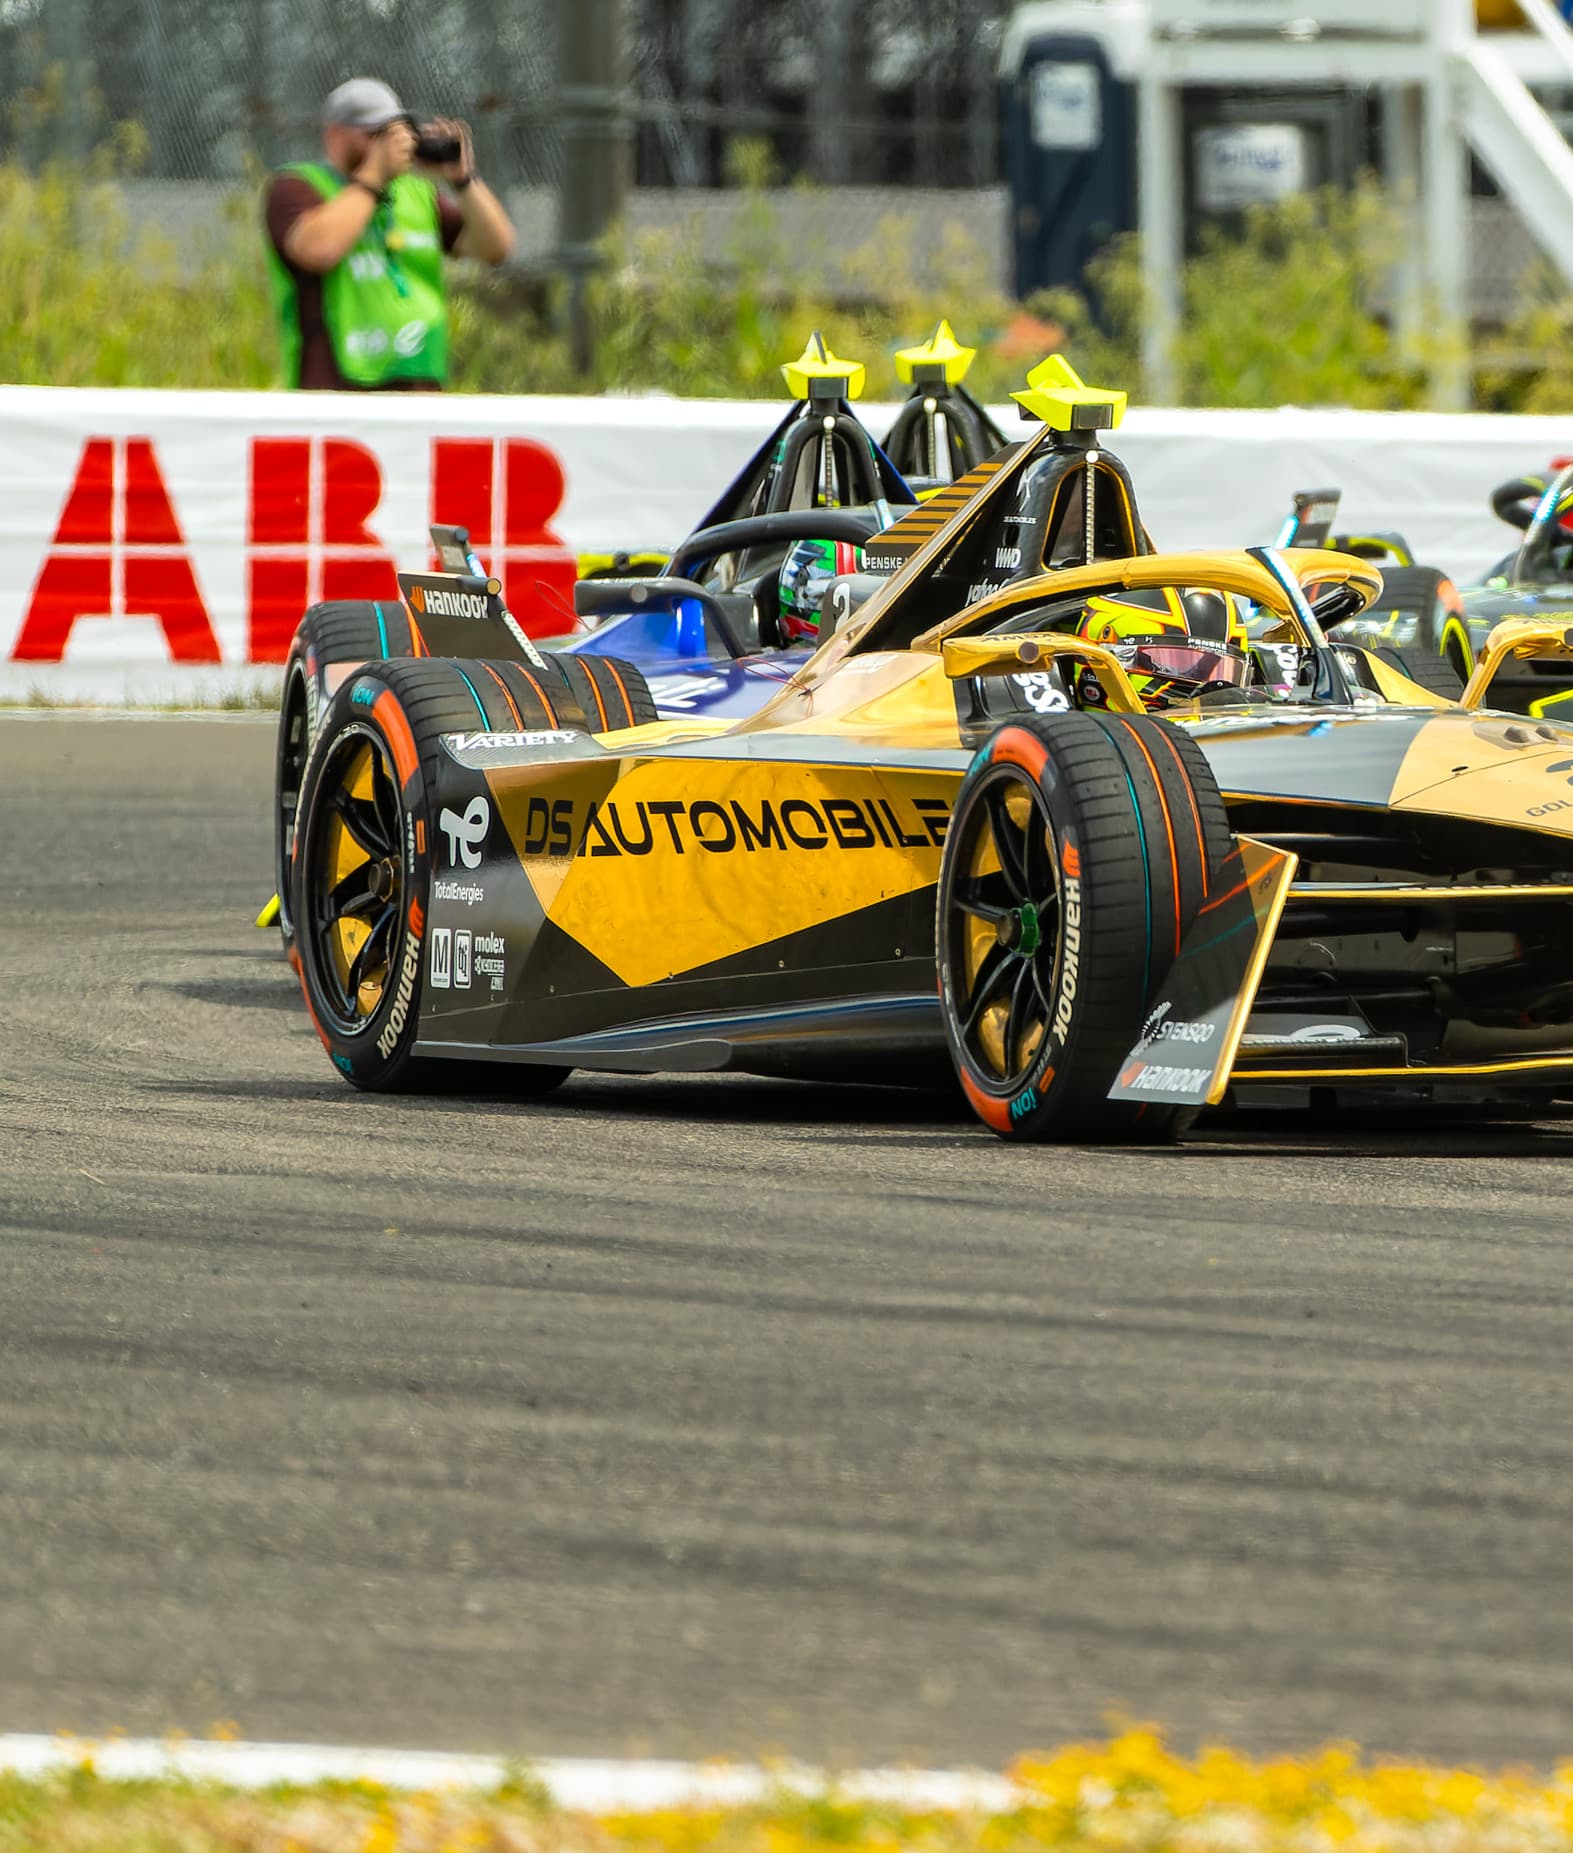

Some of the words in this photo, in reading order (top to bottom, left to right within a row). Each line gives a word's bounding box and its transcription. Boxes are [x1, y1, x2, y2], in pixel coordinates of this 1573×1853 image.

[9, 436, 582, 663] ABB
[447, 730, 580, 751] VARIETY
[577, 798, 954, 857] AUTOMOBILE
[434, 881, 484, 906] TotalEnergies
[474, 931, 505, 954] molex
